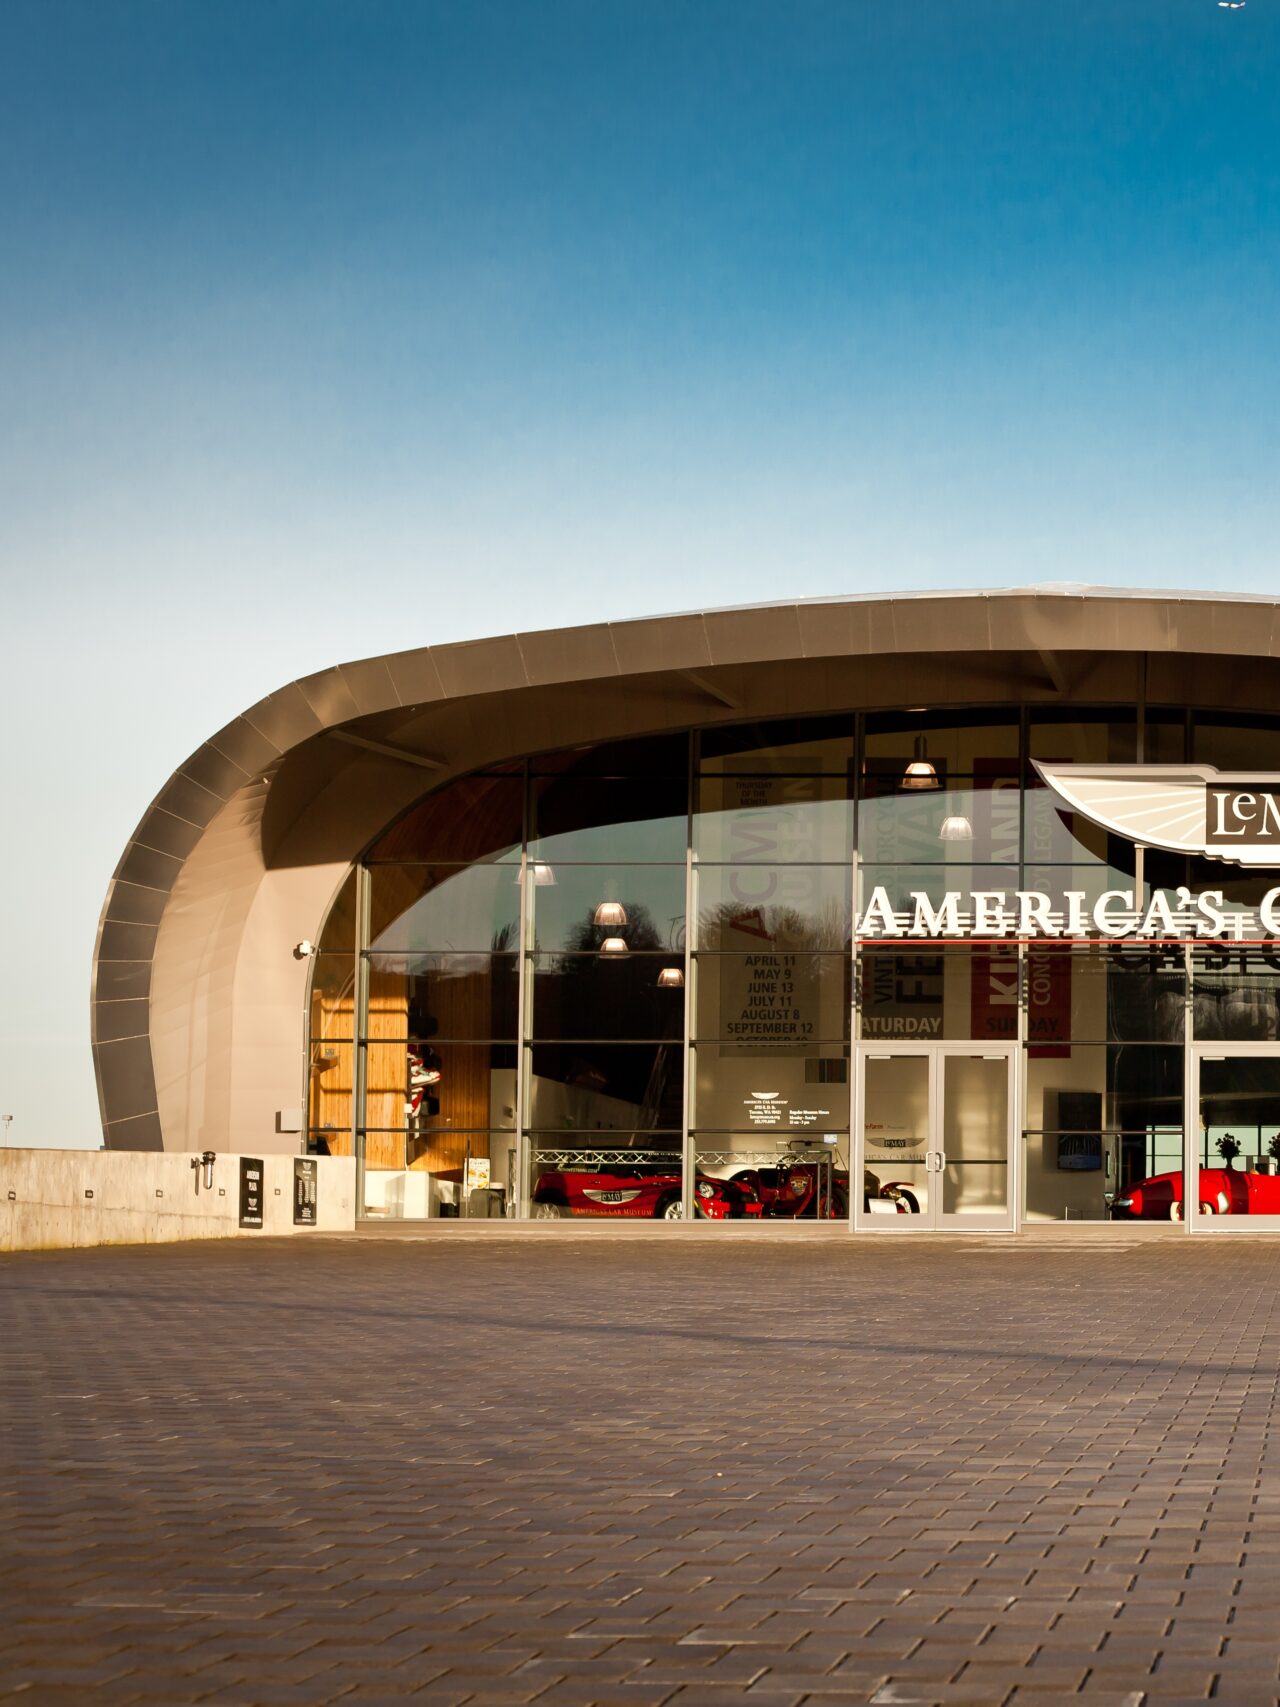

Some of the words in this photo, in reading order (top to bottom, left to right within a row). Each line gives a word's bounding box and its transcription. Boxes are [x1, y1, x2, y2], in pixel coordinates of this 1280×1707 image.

[744, 955, 780, 967] APRIL
[783, 955, 796, 967] 11
[753, 969, 781, 979] MAY
[784, 969, 792, 979] 9
[747, 982, 777, 993] JUNE
[781, 982, 794, 993] 13
[748, 996, 775, 1007] JULY
[780, 996, 792, 1007] 11
[741, 1009, 790, 1020] AUGUST
[792, 1009, 800, 1020] 8
[727, 1022, 797, 1034] SEPTEMBER
[800, 1022, 814, 1034] 12
[848, 1017, 942, 1033] ATURDAY
